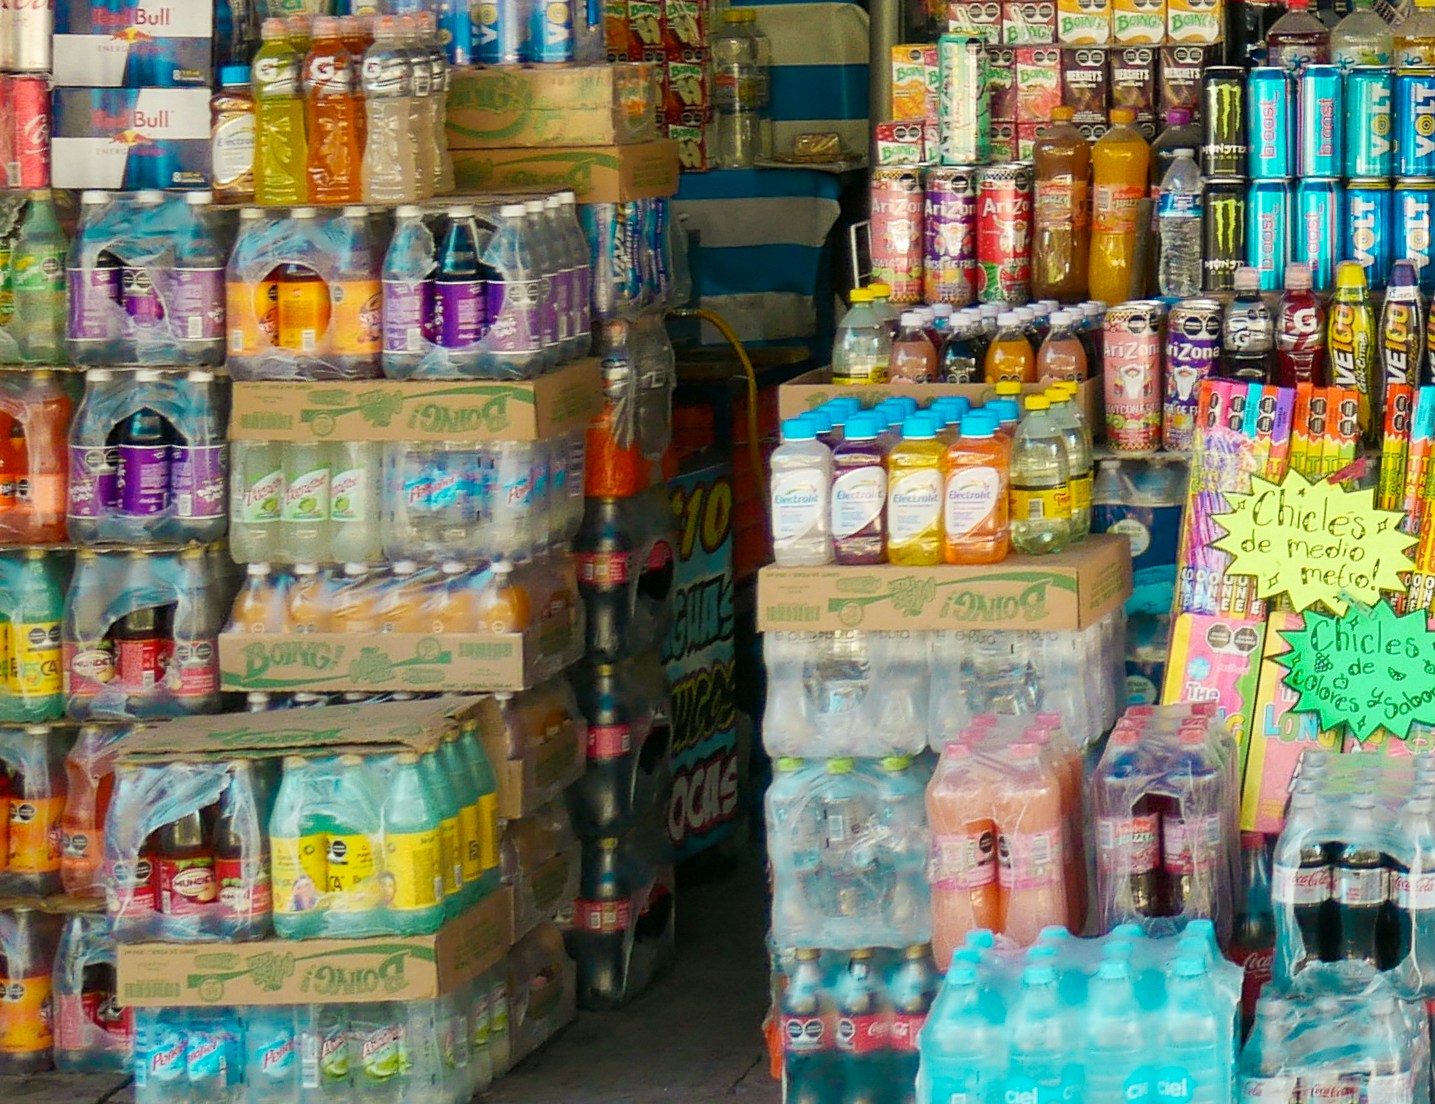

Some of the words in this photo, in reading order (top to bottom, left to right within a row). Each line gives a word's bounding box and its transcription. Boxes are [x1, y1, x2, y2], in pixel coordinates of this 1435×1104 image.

[1372, 82, 1391, 157] VOLT
[1415, 82, 1435, 157] VOLT
[1353, 197, 1375, 266] VOLT
[1408, 197, 1430, 267] VOLT
[774, 492, 820, 505] Electrolit
[836, 488, 884, 501] Electrolit
[893, 492, 939, 505] Electrolit
[948, 489, 993, 501] Electrolit
[1252, 490, 1366, 541] Chicles
[1241, 534, 1273, 554] de
[1288, 537, 1365, 562] medio
[1300, 559, 1380, 591] metro!
[946, 580, 1052, 622] BOING!
[1309, 620, 1420, 657] Chicles
[1348, 657, 1375, 676] de
[1157, 1077, 1189, 1096] ciel
